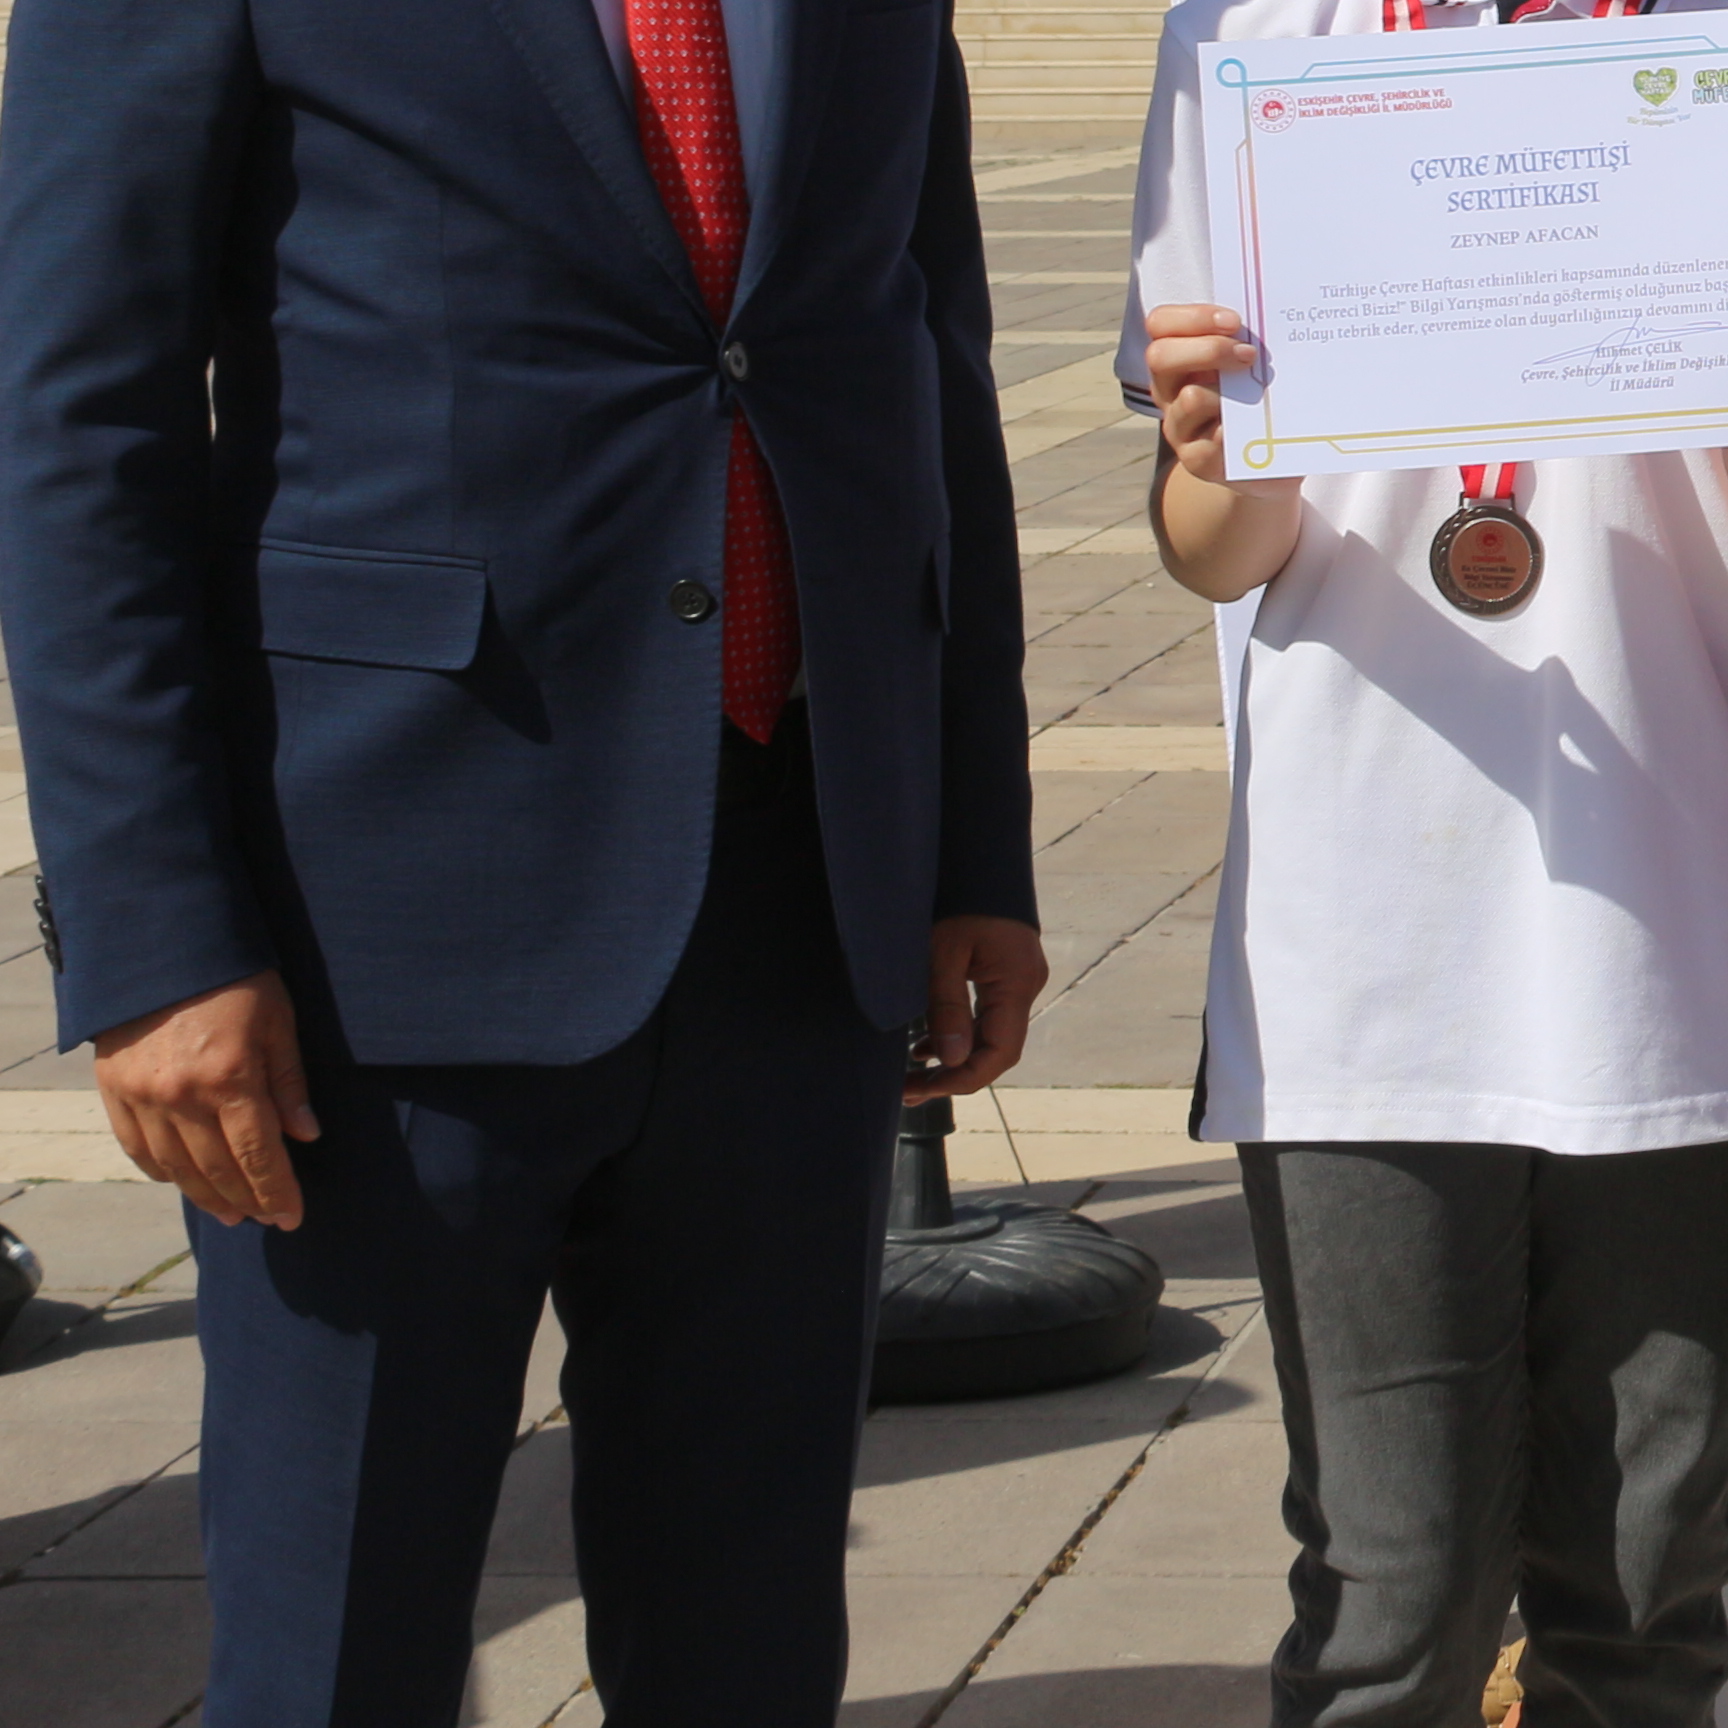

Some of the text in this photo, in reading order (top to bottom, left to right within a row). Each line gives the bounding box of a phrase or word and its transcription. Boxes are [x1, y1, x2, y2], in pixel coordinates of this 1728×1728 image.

[1409, 139, 1631, 186] ÇEVRE MÜFETTİŞİ
[1446, 180, 1600, 213] SERTİFİKASI
[1449, 224, 1598, 249] ZEYNEP AFACAN
[1318, 282, 1377, 300] Türkiye
[1378, 280, 1419, 298] Çevre
[1420, 275, 1475, 292] Haftası
[1476, 268, 1558, 288] etkinlikleri
[1560, 261, 1650, 284] kapsamında
